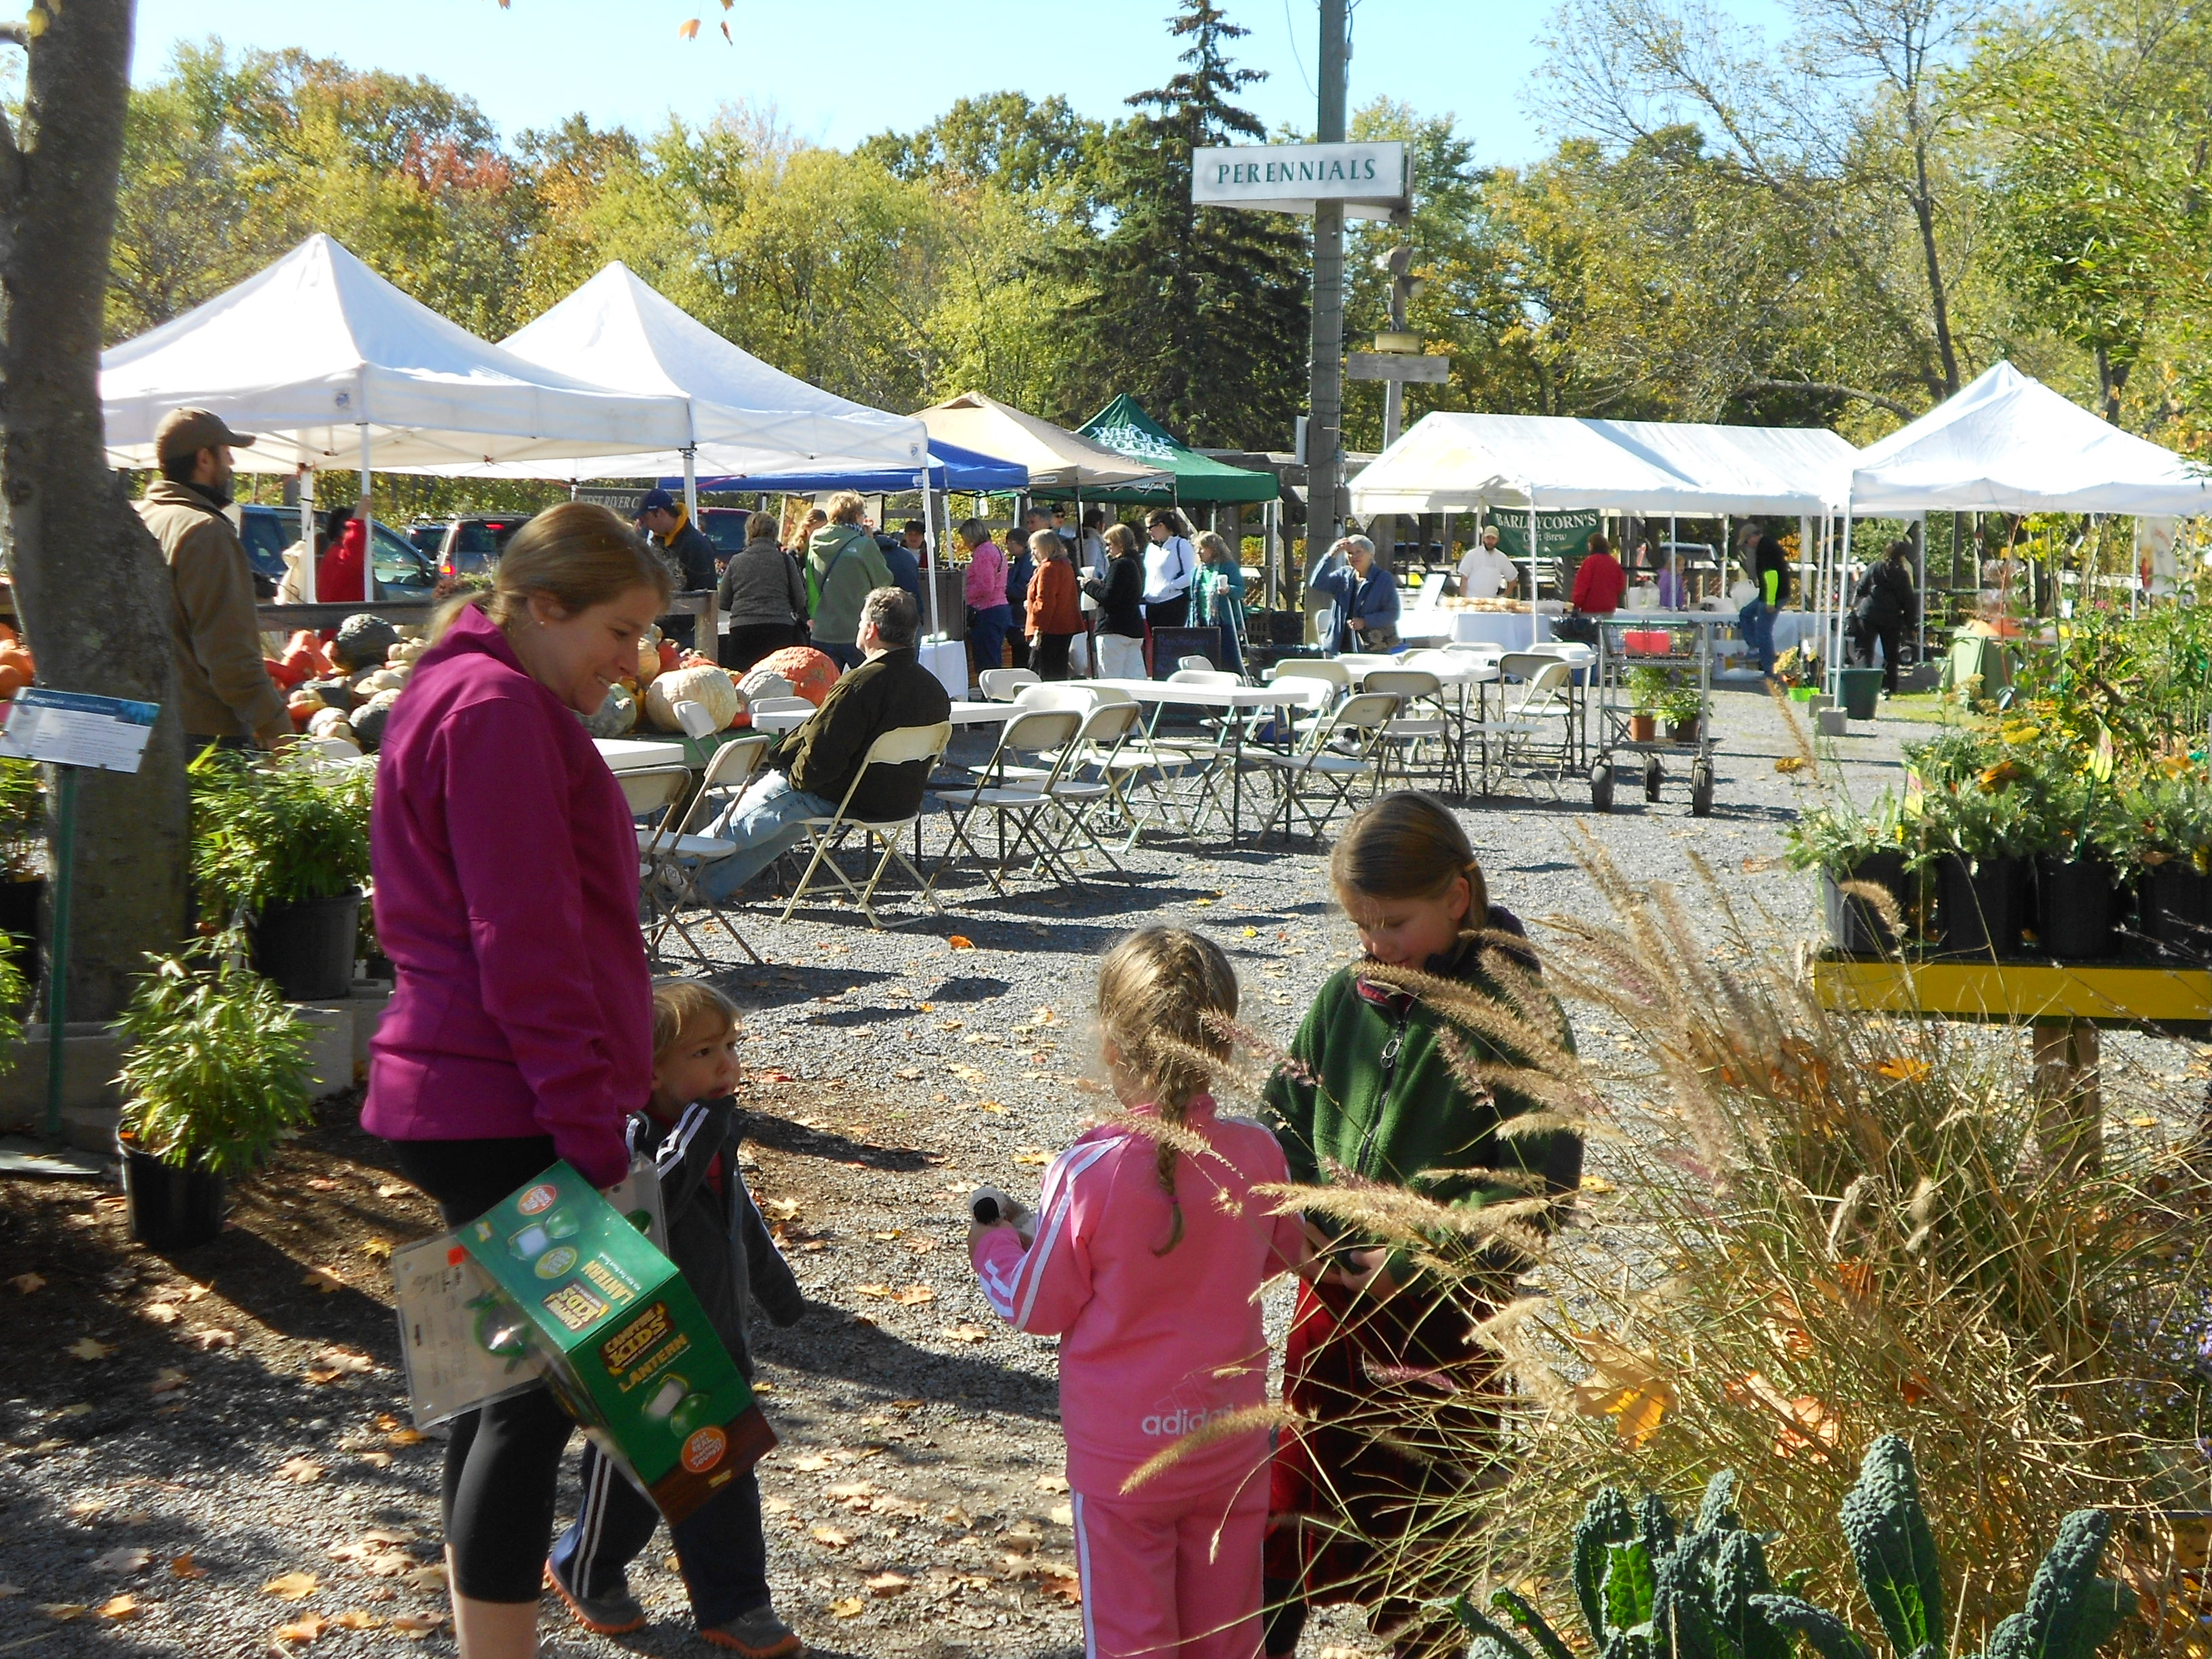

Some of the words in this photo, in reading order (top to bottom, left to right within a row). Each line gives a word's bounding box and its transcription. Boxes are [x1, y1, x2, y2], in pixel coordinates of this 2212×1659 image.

[1217, 158, 1376, 184] PERENNIALS
[1091, 424, 1170, 445] WHOLE
[1100, 438, 1173, 456] FOODS
[604, 495, 630, 508] RIVER
[1544, 532, 1568, 541] Brew
[580, 1260, 634, 1305] LANTERN
[556, 1287, 599, 1322] KIDS
[609, 1315, 665, 1367] KIDS
[618, 1333, 688, 1393] LANTERN
[1141, 1404, 1234, 1436] adid
[693, 1437, 714, 1454] REAL
